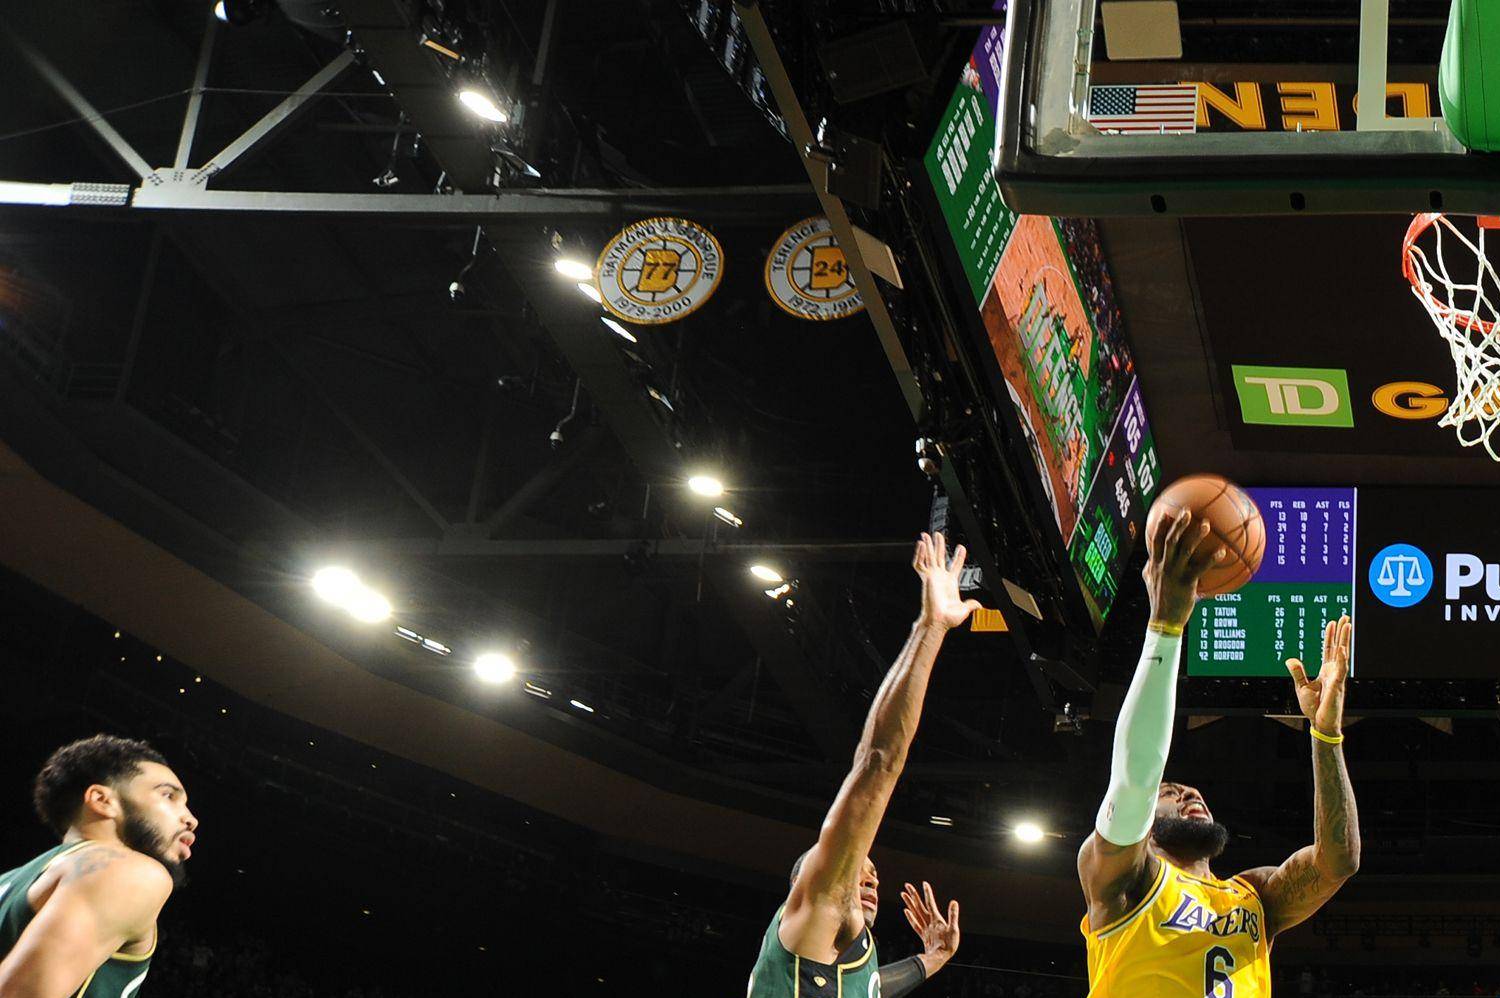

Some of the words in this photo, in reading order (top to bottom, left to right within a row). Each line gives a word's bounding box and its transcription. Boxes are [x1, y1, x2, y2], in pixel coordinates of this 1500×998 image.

[645, 262, 676, 280] 77
[814, 260, 845, 276] 24
[1245, 377, 1340, 416] TD
[1124, 404, 1141, 454] 105
[1138, 452, 1155, 496] 107
[1278, 512, 1286, 521] 13
[1268, 595, 1280, 603] PTS
[1290, 595, 1303, 603] REB
[1314, 595, 1327, 603] AST
[1337, 595, 1348, 603] FLS
[1214, 608, 1236, 616] TATUM
[1275, 608, 1284, 616] 26
[1214, 619, 1237, 627] BROWN
[1275, 619, 1284, 627] 27
[1200, 630, 1207, 638] 12
[1214, 630, 1246, 638] WILLIAMS
[1200, 641, 1207, 649] 13
[1214, 641, 1245, 649] BROGDON
[1275, 641, 1284, 649] 22
[1214, 652, 1244, 660] HORFORD
[1160, 893, 1260, 942] LAKERS
